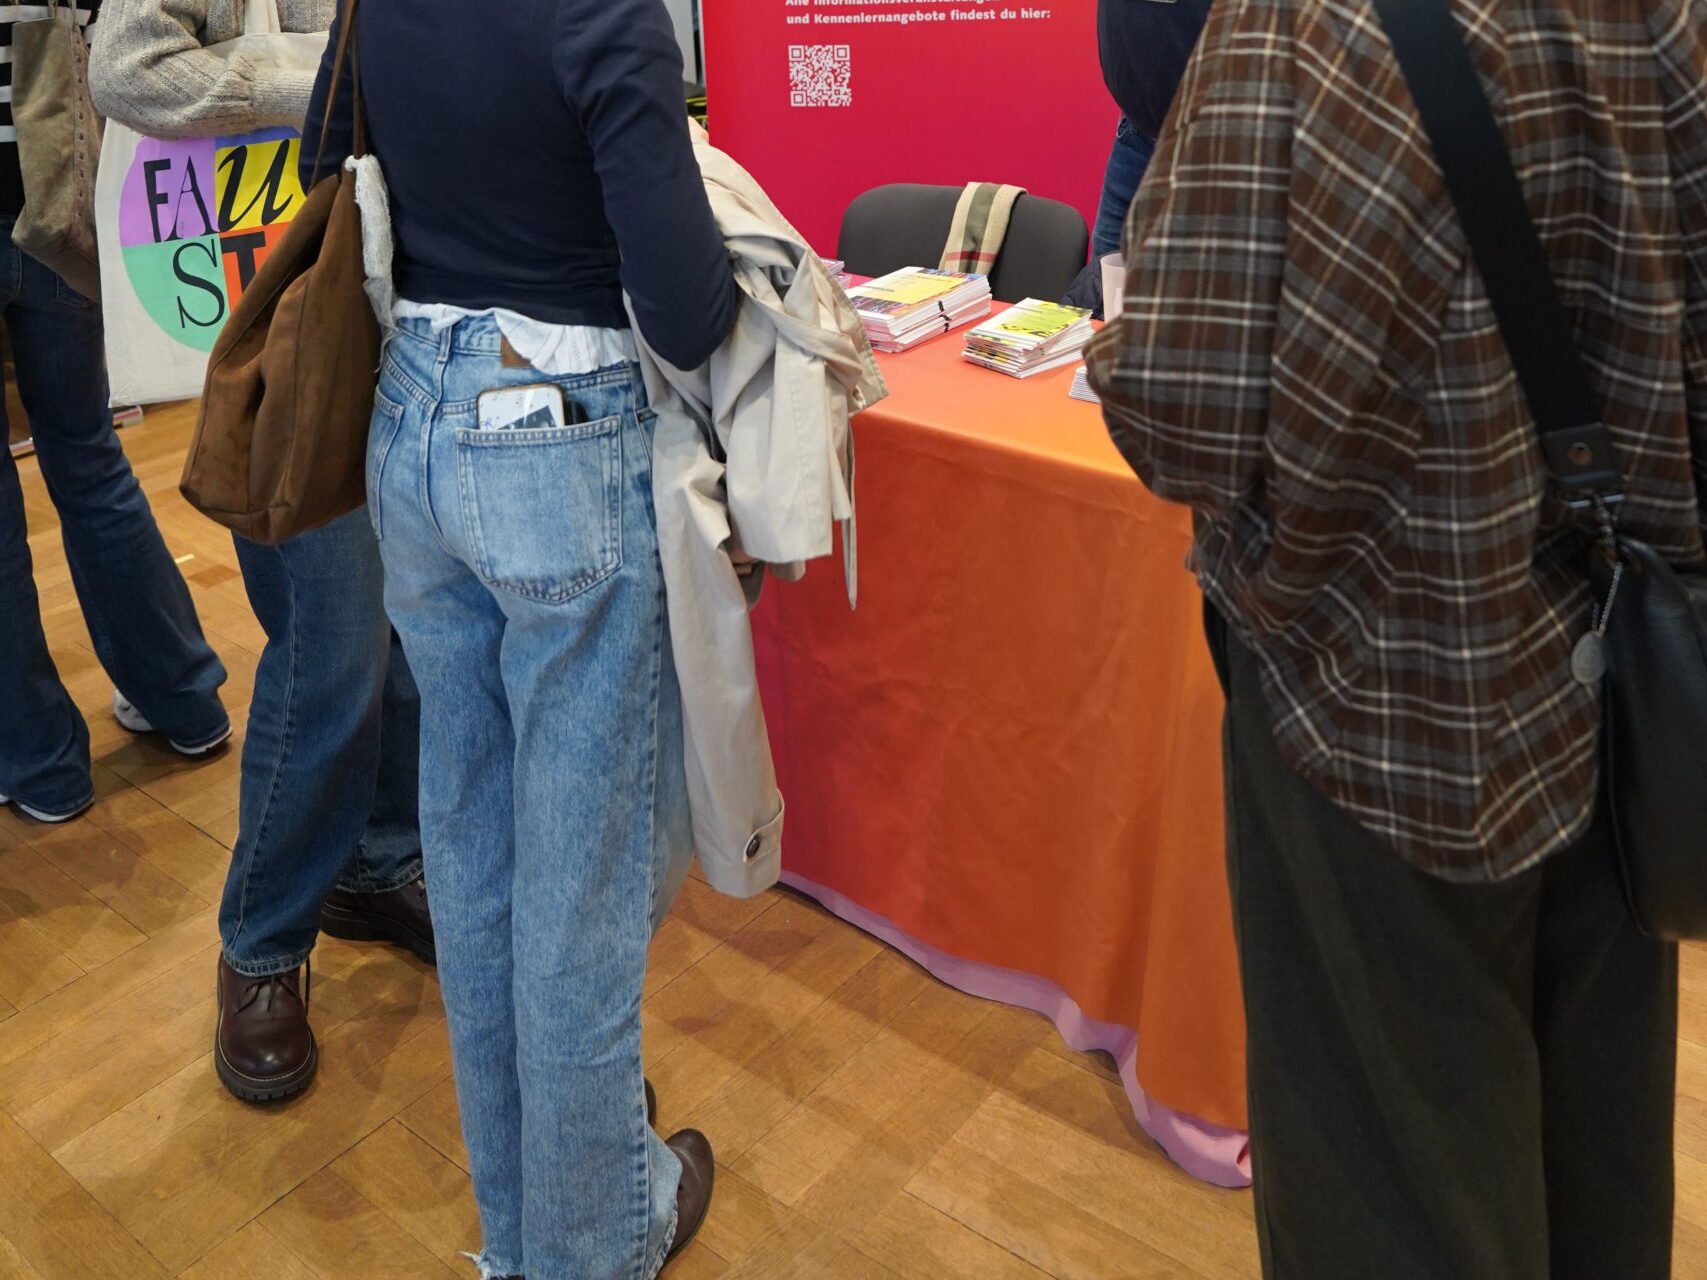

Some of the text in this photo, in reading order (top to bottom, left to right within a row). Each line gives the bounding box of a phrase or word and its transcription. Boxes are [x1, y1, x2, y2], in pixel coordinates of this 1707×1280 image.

[787, 8, 1050, 24] und Kennenlernangebote findest du hier:
[143, 139, 293, 243] FAU
[172, 231, 266, 328] ST
